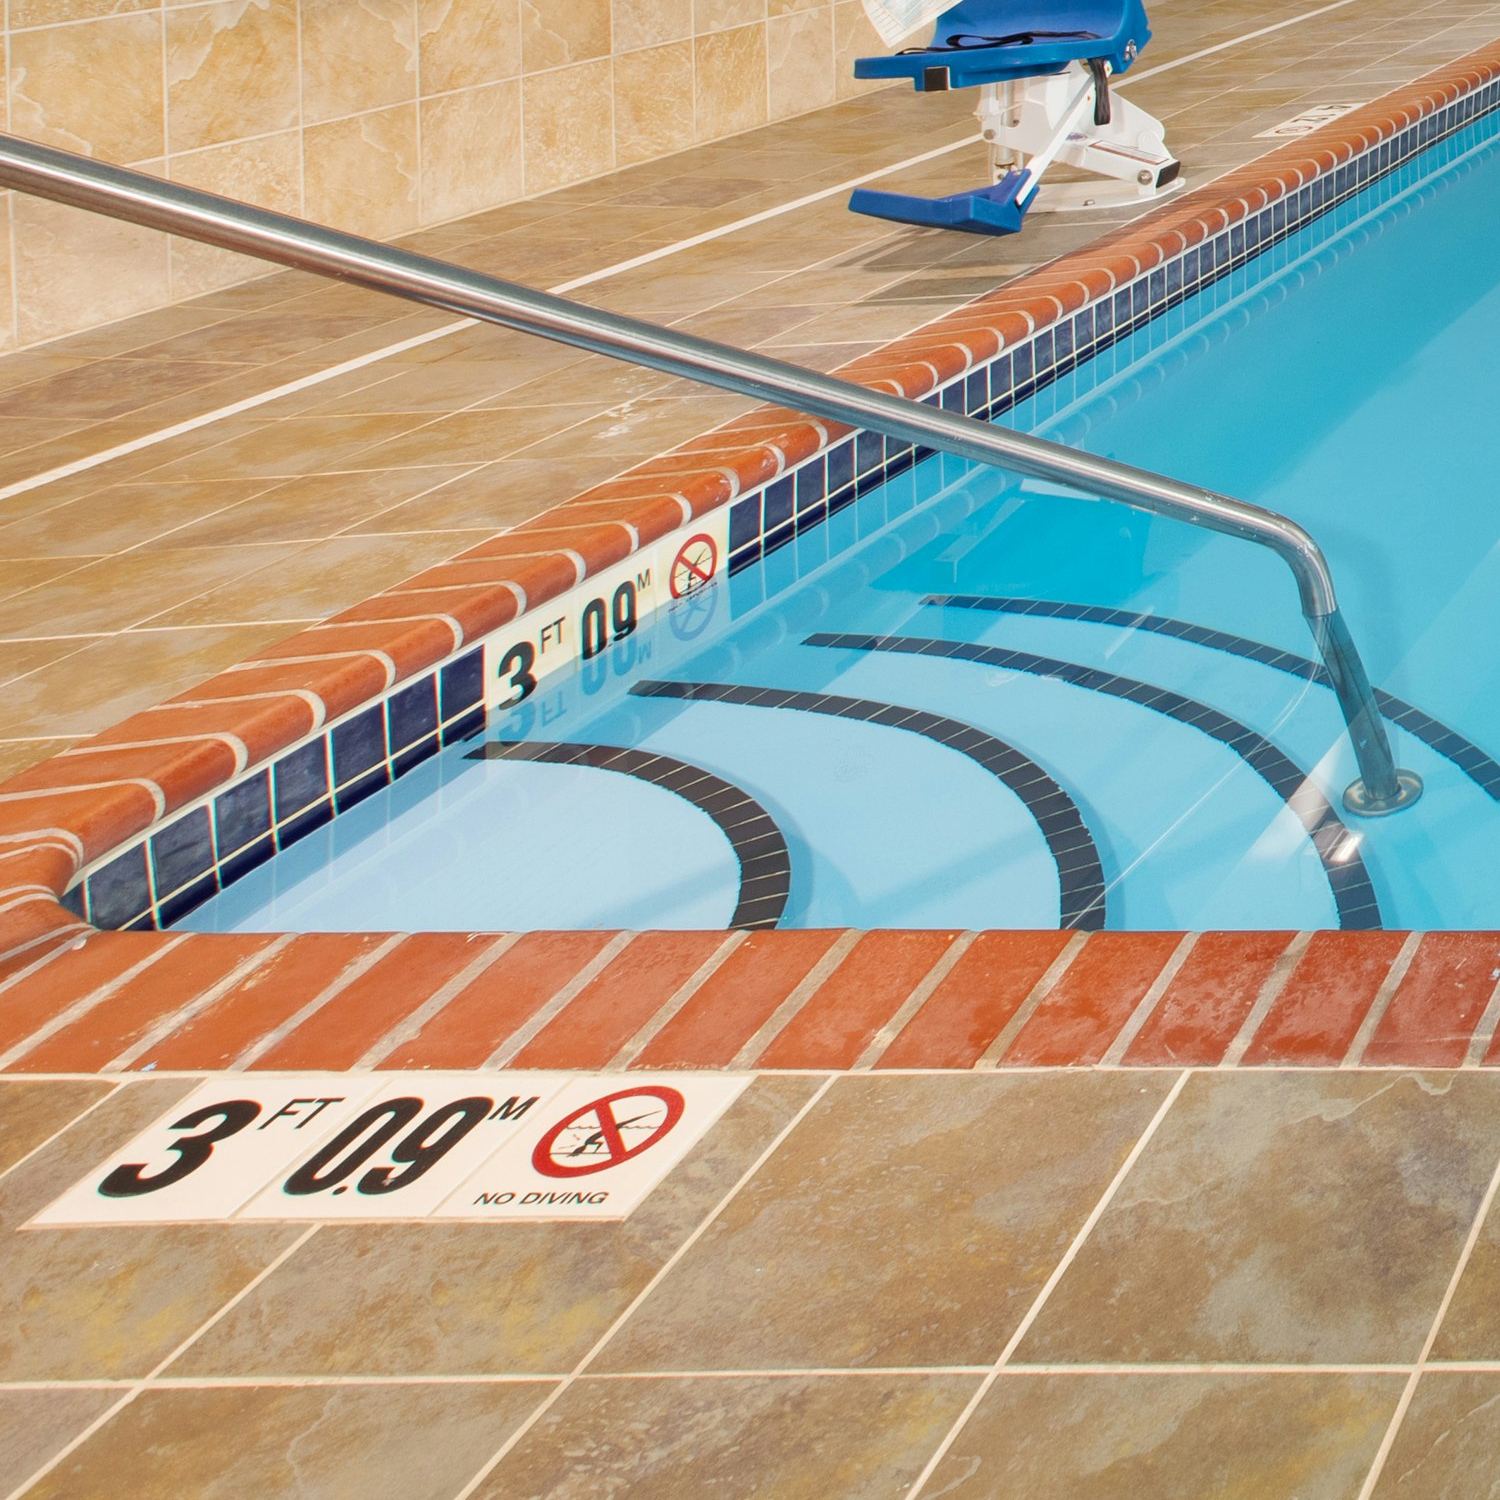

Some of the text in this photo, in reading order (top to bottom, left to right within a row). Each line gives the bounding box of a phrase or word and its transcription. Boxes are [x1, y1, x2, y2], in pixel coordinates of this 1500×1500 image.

[498, 641, 538, 709] 3
[541, 616, 566, 654] FT
[637, 568, 651, 591] M
[97, 1096, 541, 1198] 3 FT 0.9 M
[472, 1191, 610, 1205] NO DIVING
